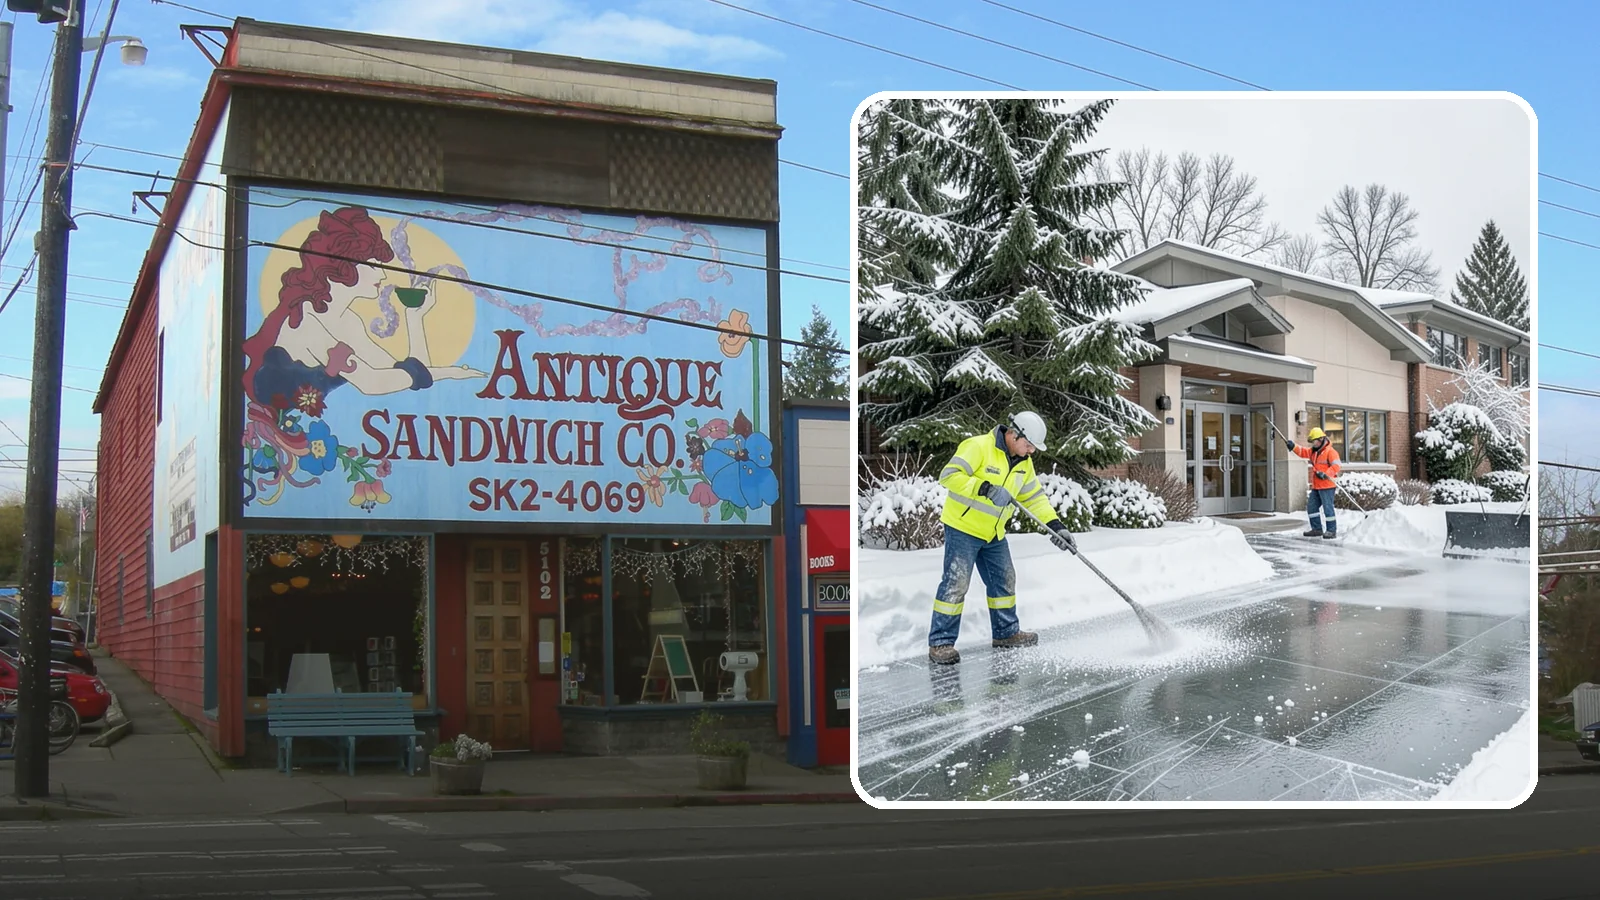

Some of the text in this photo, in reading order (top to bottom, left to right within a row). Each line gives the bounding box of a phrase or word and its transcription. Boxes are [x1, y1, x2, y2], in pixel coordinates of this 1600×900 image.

[475, 328, 723, 421] ANTIQUE
[361, 408, 685, 468] SANDWICH CO.
[469, 476, 645, 513] SK2-4069
[539, 541, 552, 600] 5102
[809, 555, 835, 569] BOOKS
